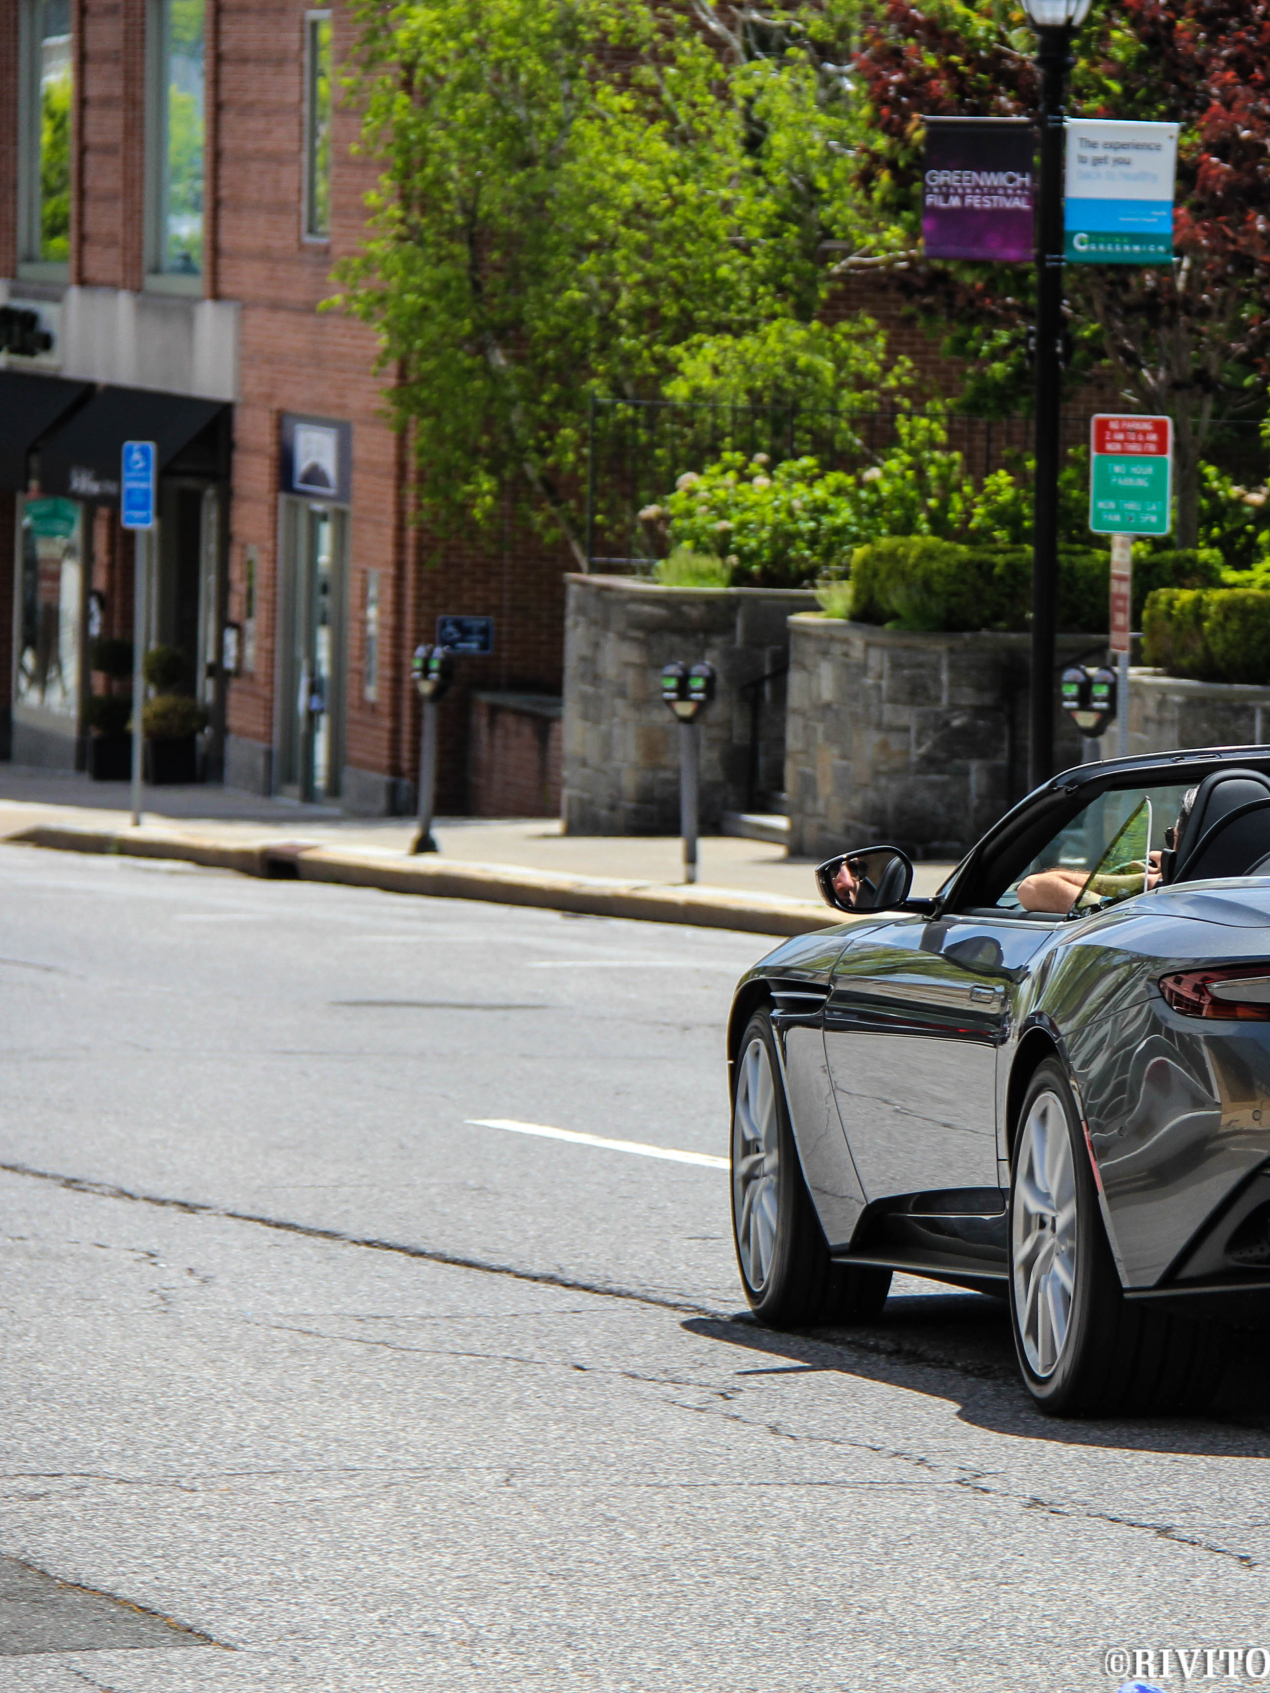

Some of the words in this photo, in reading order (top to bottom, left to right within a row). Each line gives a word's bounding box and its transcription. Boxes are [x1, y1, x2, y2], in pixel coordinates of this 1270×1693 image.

[1078, 137, 1099, 149] The
[1102, 139, 1163, 151] experience
[1077, 154, 1088, 164] to
[1091, 155, 1109, 167] get
[1112, 157, 1131, 167] you
[924, 169, 1032, 187] GREENWICH
[925, 187, 1031, 195] INTERNATIONAL
[925, 194, 962, 207] FILM
[964, 195, 1032, 210] FESTIVAL
